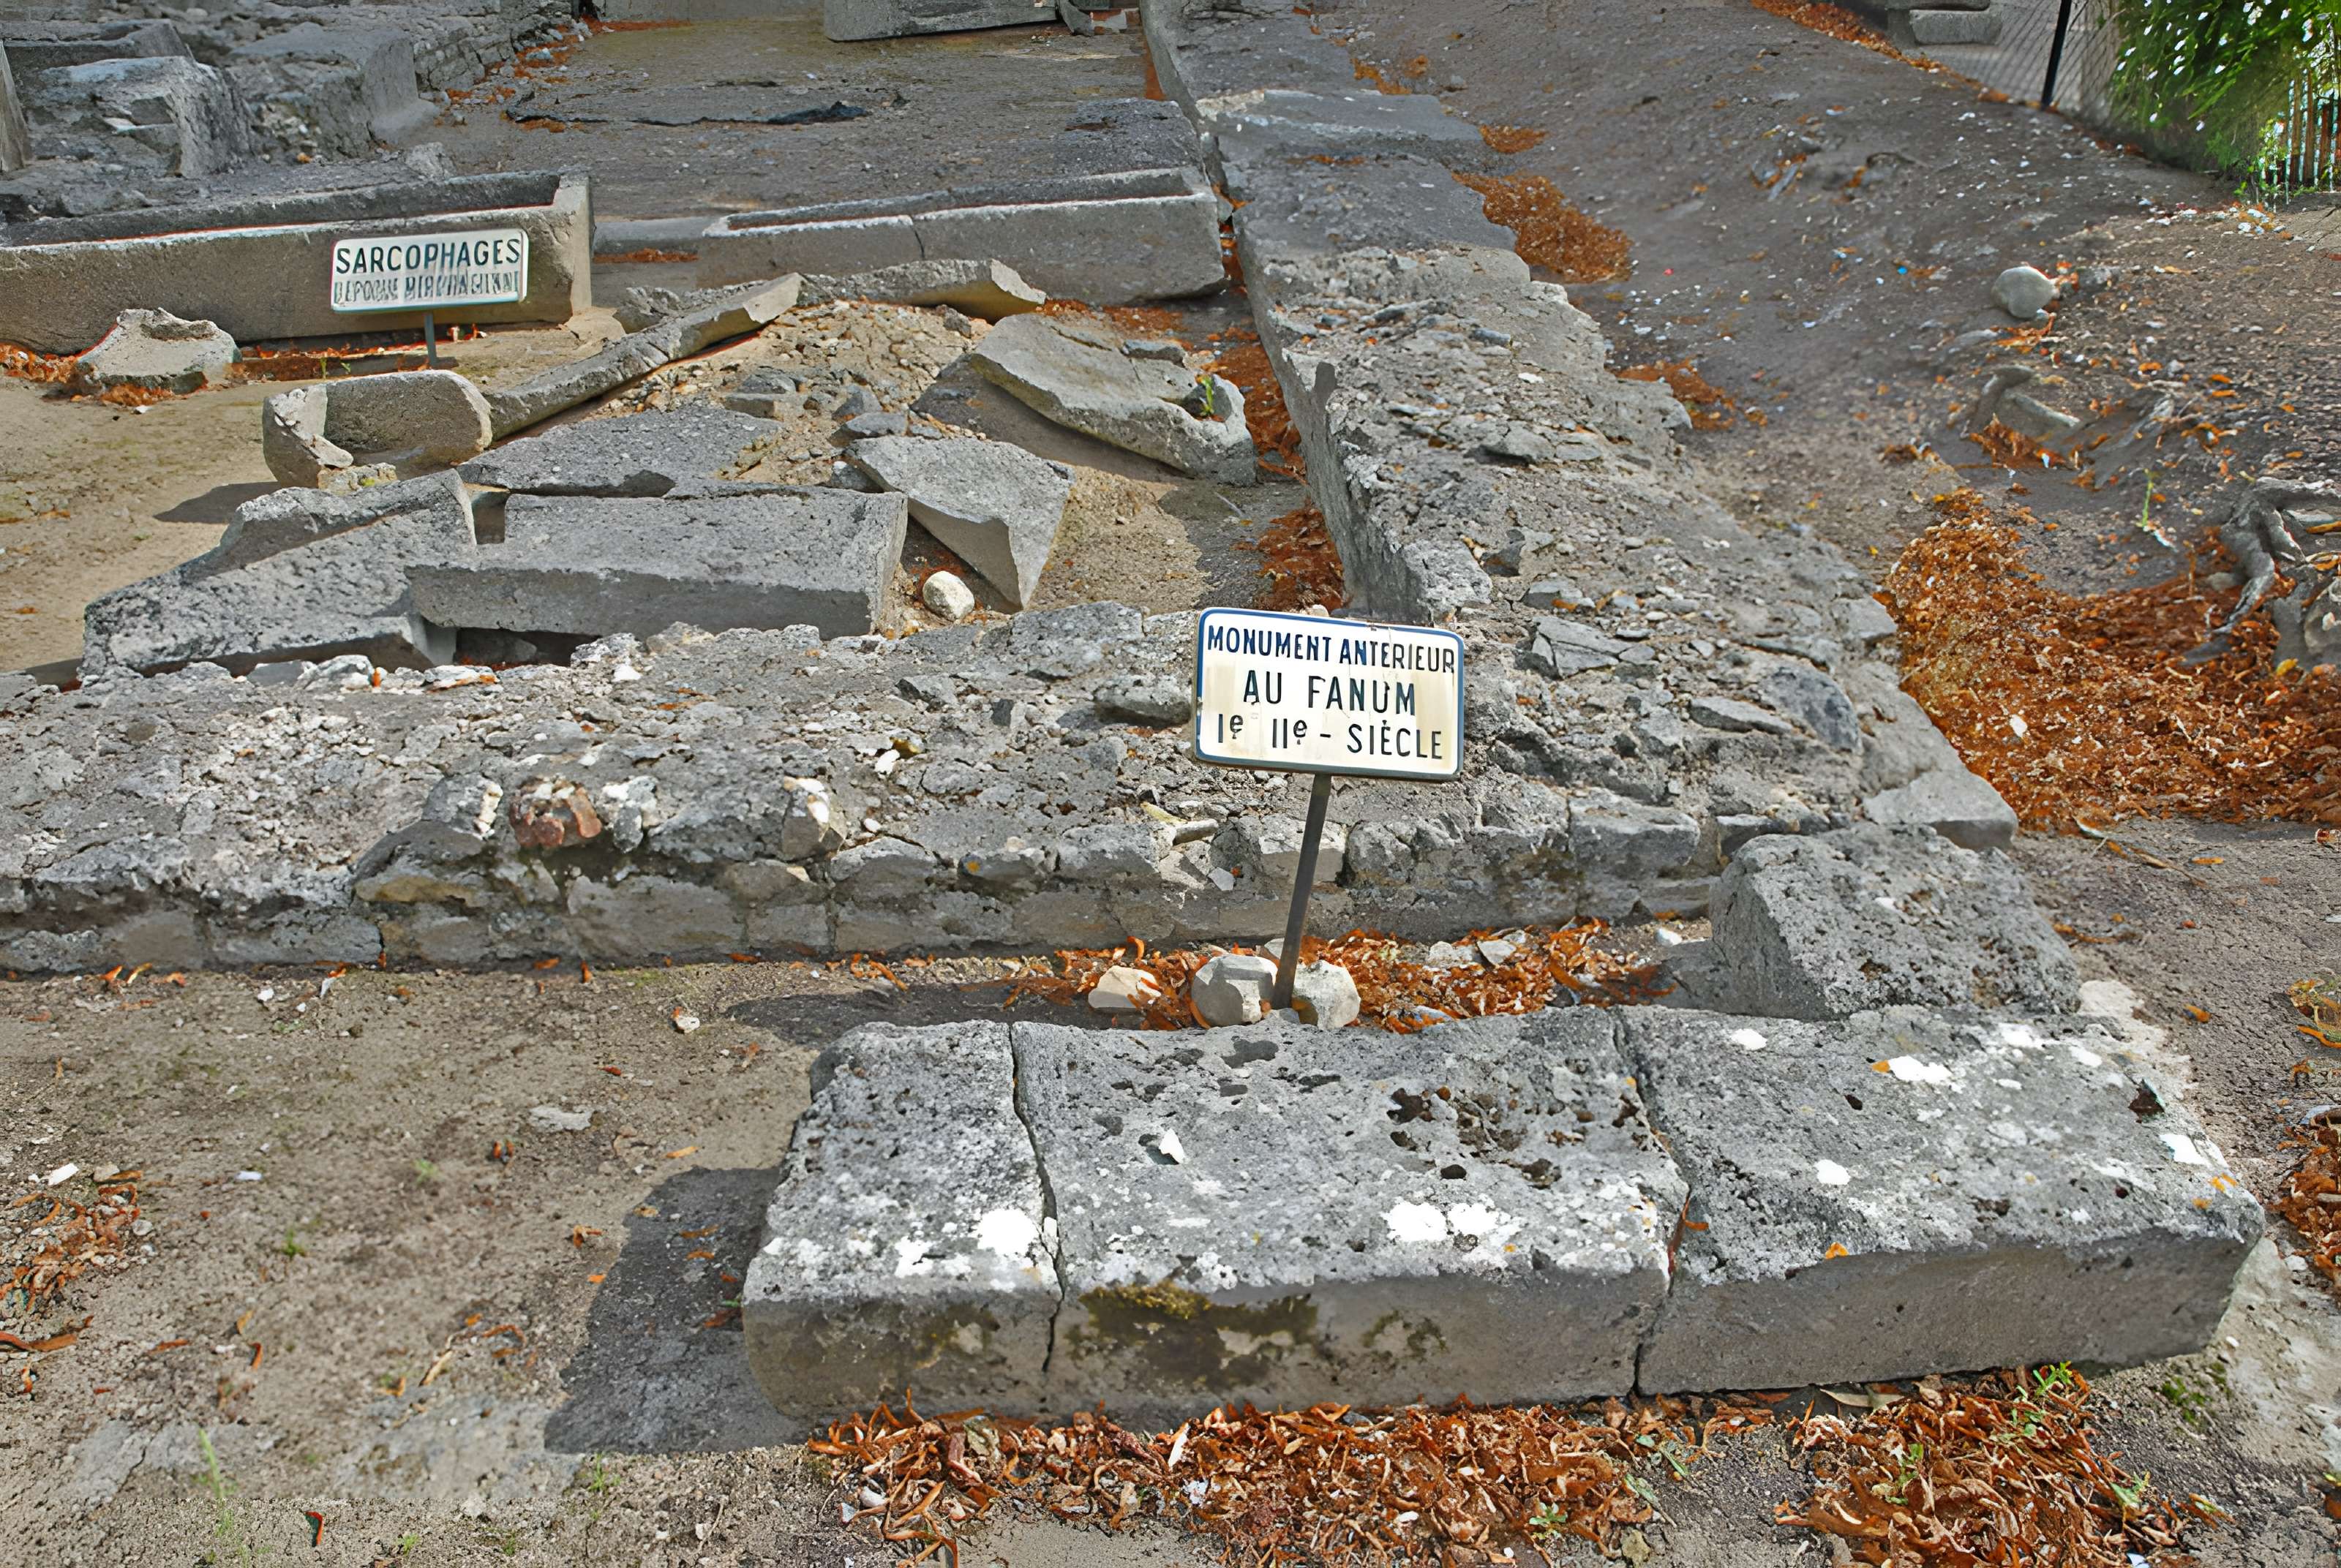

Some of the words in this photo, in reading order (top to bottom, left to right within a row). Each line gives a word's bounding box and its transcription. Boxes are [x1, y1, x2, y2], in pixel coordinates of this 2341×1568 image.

[336, 238, 521, 274] SARCOPHAGES
[1207, 625, 1331, 661] MONUMENT
[1339, 638, 1455, 674] ANTERIEUR
[1243, 669, 1282, 704] AU
[1307, 675, 1416, 716] FANUM
